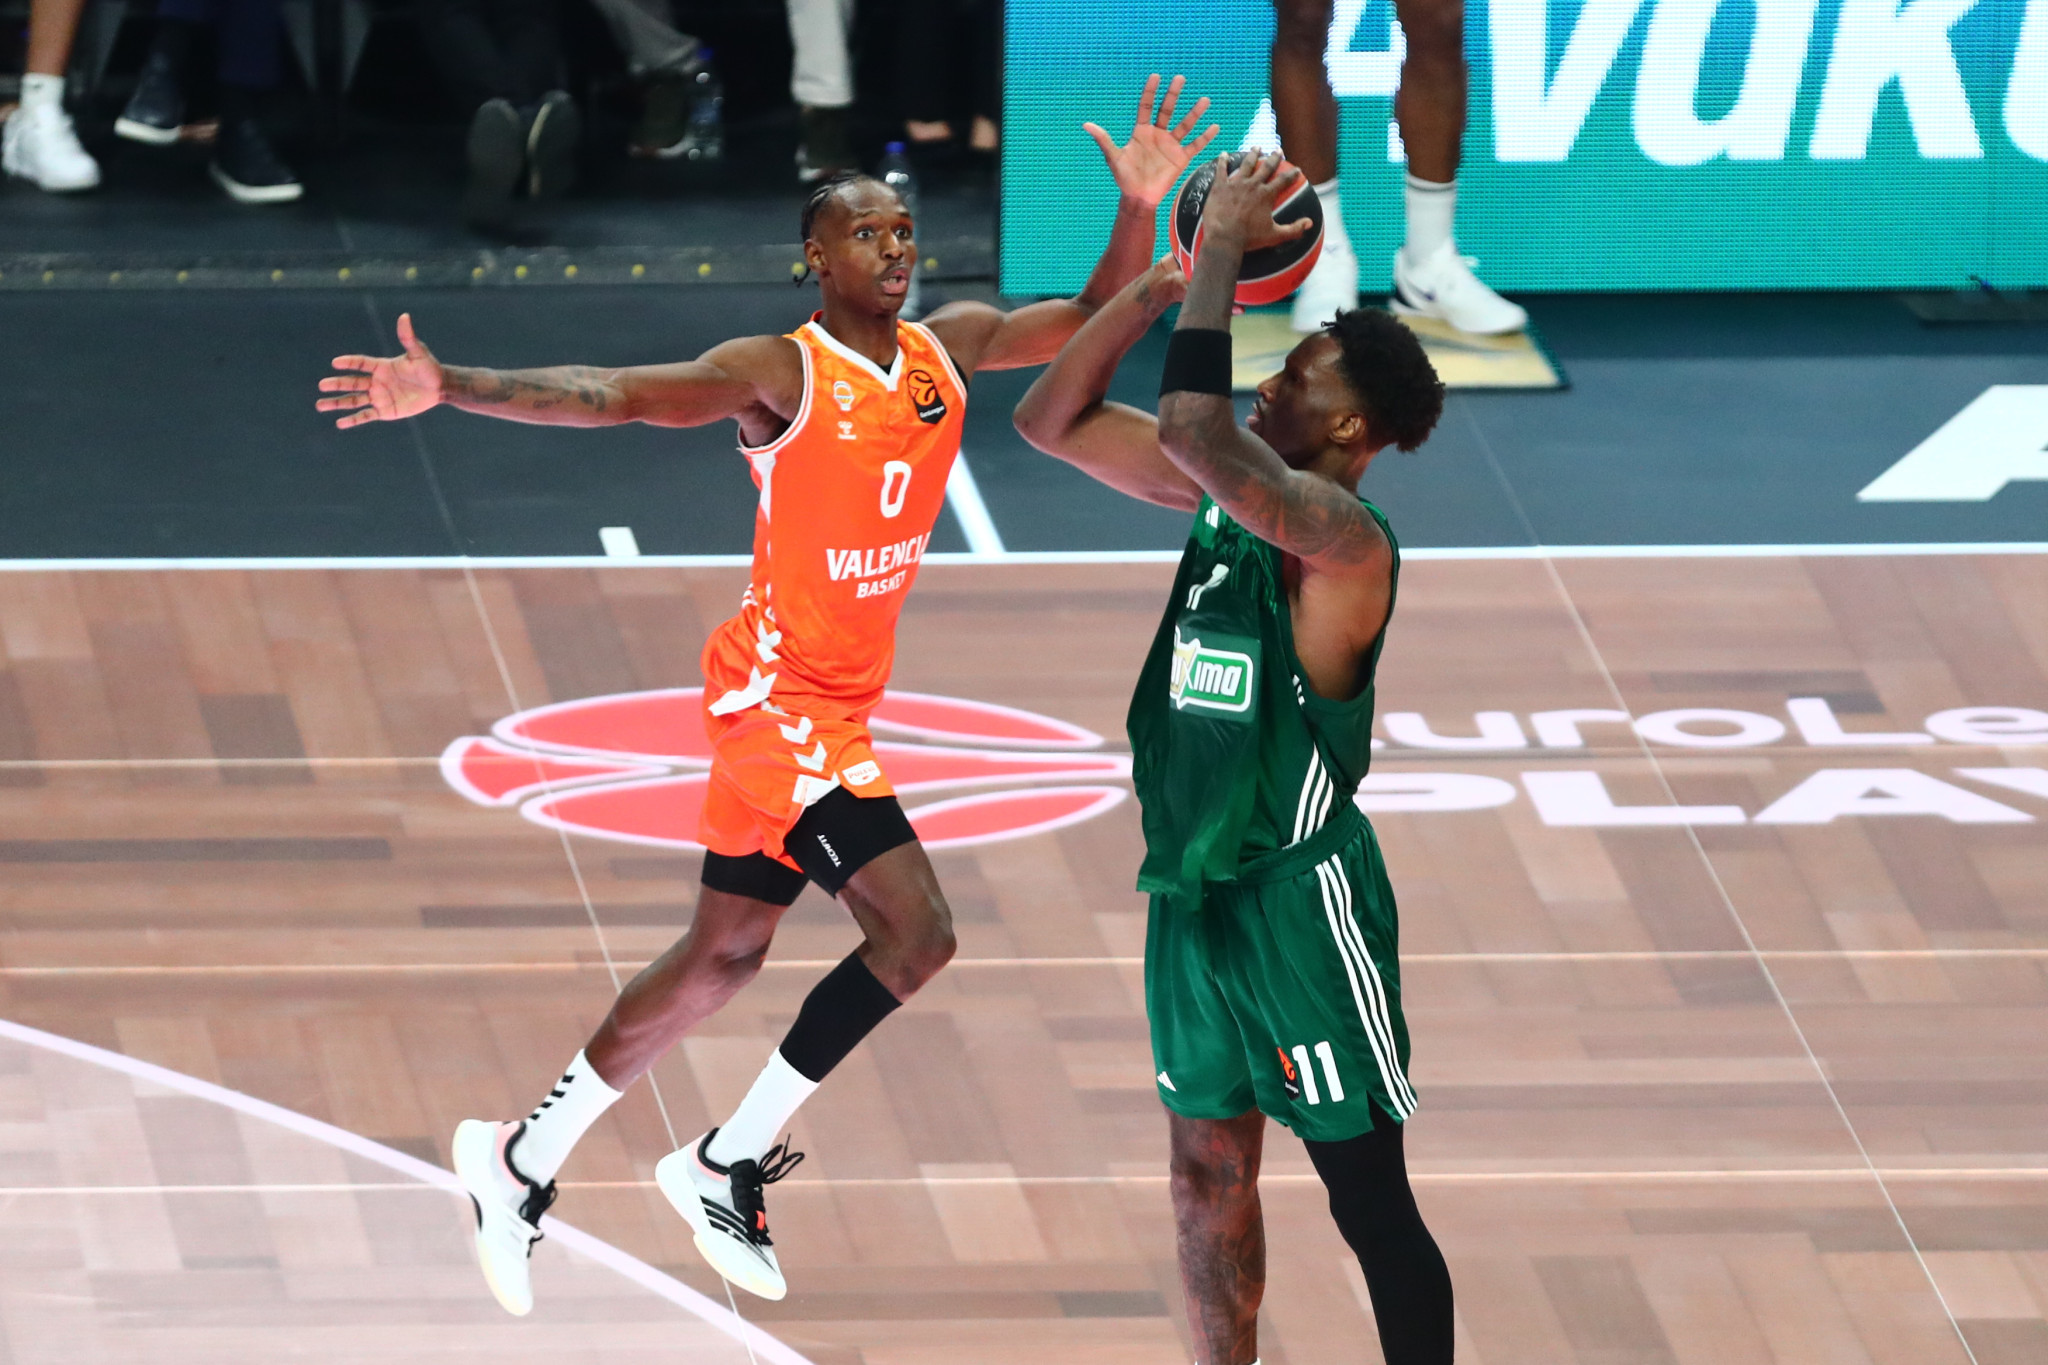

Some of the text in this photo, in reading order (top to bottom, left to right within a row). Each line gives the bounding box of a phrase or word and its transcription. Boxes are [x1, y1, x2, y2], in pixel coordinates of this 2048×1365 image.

[880, 460, 912, 519] 0
[855, 570, 906, 599] BASKET
[1371, 697, 2048, 750] uroLe
[1291, 1040, 1345, 1105] 11
